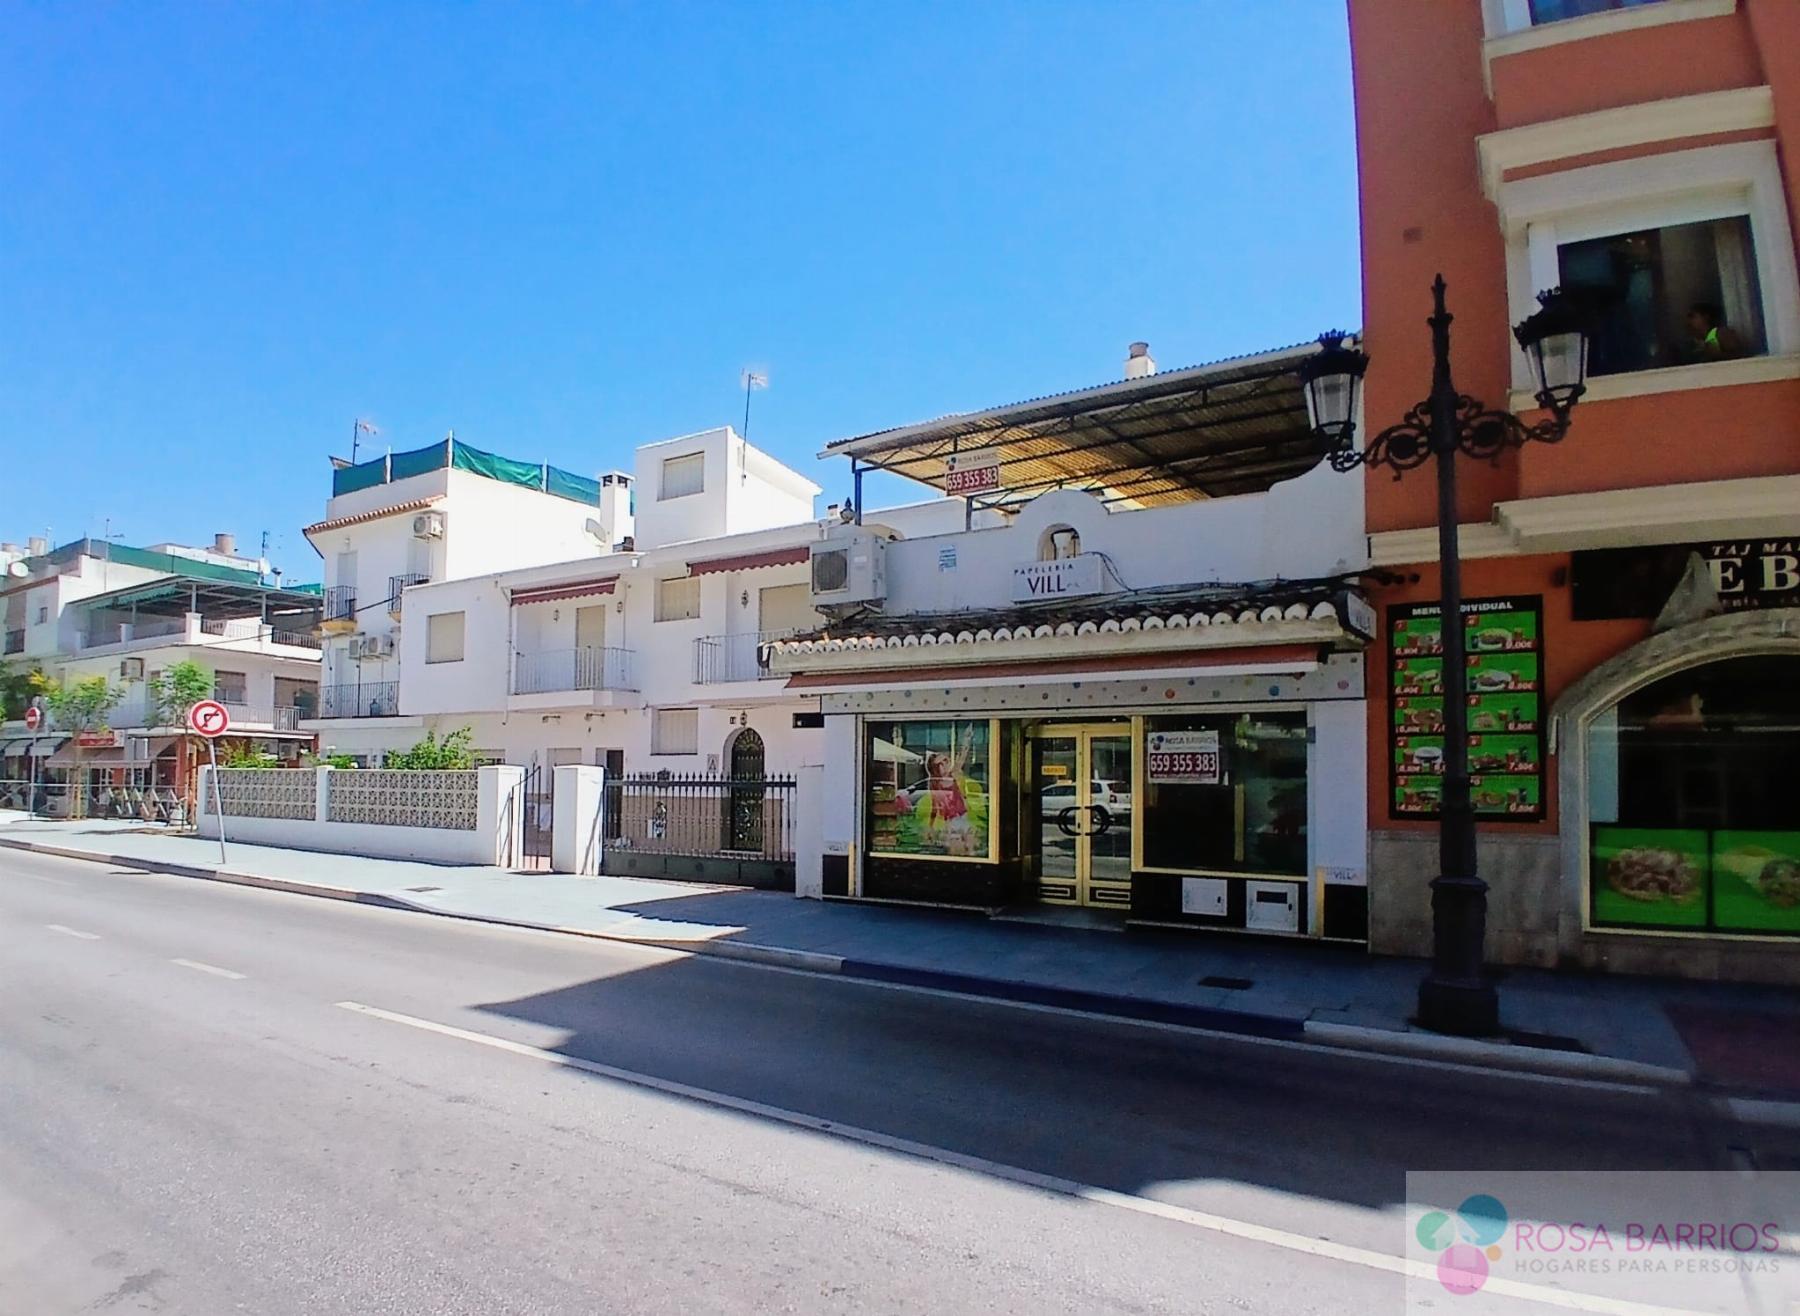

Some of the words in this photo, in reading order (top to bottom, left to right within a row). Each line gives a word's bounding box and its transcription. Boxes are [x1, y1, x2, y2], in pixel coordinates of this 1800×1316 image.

[947, 473, 963, 490] 659
[963, 470, 980, 487] 355
[981, 467, 998, 484] 383
[1712, 544, 1751, 556] TAJ
[1762, 542, 1800, 553] MA
[1460, 601, 1514, 613] DIVIDUAL
[1150, 754, 1170, 771] 659
[1172, 754, 1193, 771] 355
[1195, 754, 1216, 771] 383
